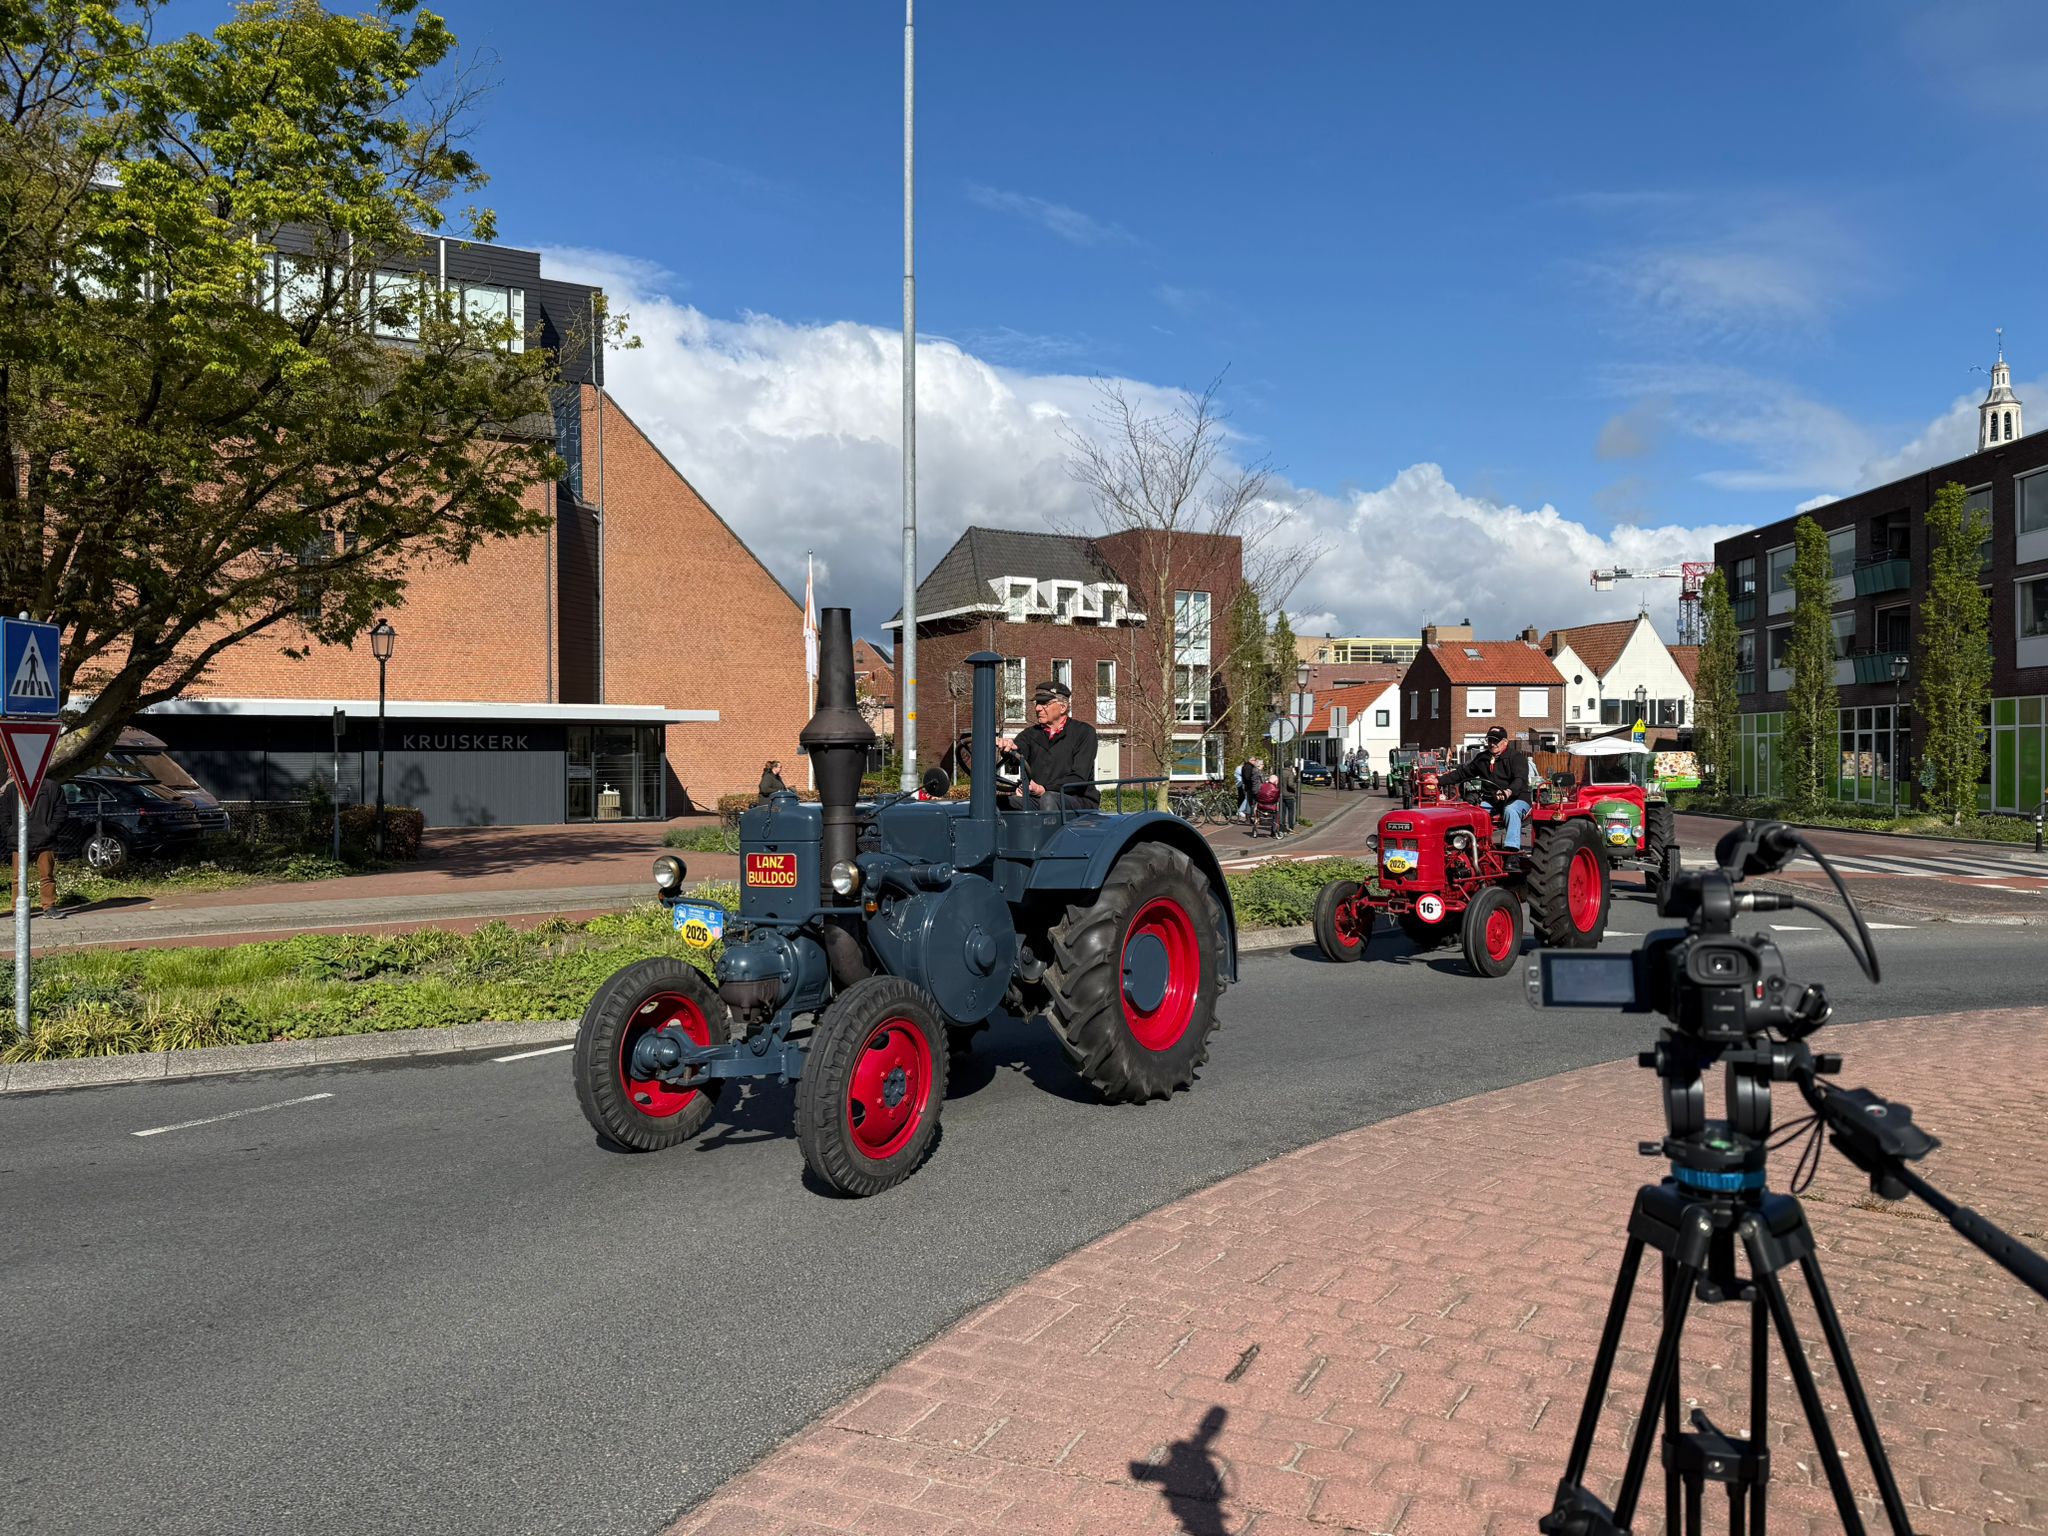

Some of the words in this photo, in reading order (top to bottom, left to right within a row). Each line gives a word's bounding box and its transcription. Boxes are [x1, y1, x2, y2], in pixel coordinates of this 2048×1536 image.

[403, 735, 529, 750] KRUISKERK
[1387, 823, 1411, 831] FAHR
[756, 856, 785, 869] LANZ
[1389, 859, 1406, 869] 2026
[748, 871, 795, 885] BULLDOG
[1421, 902, 1434, 914] 16
[686, 925, 708, 942] 2026
